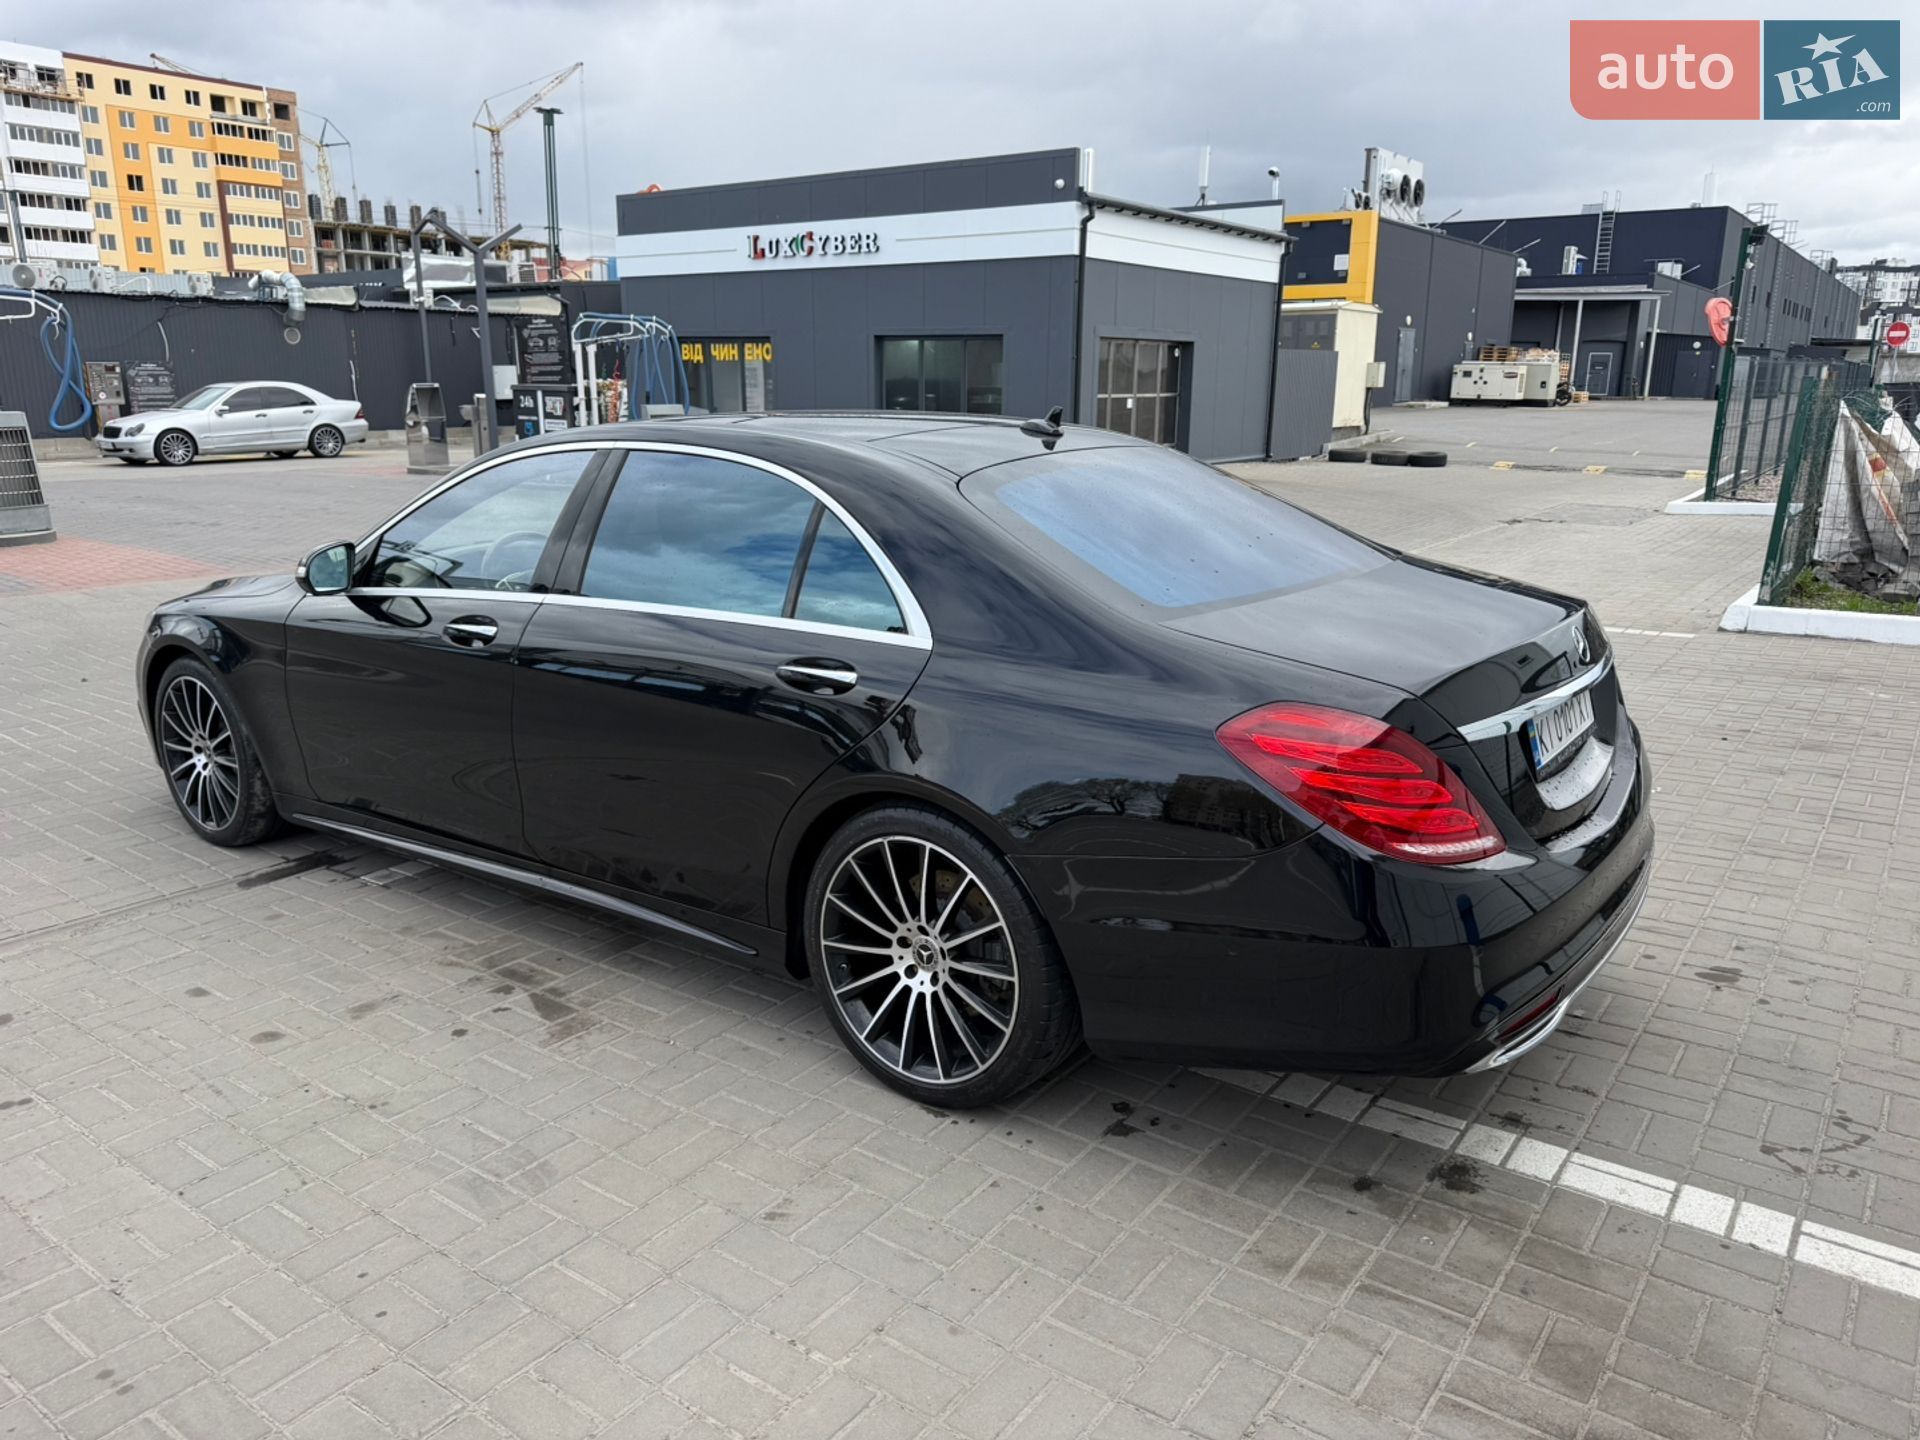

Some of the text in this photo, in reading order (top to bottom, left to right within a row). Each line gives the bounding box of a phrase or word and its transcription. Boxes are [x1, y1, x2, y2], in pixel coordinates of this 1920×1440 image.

[681, 342, 772, 364] ВІД ЧИН ЕНО
